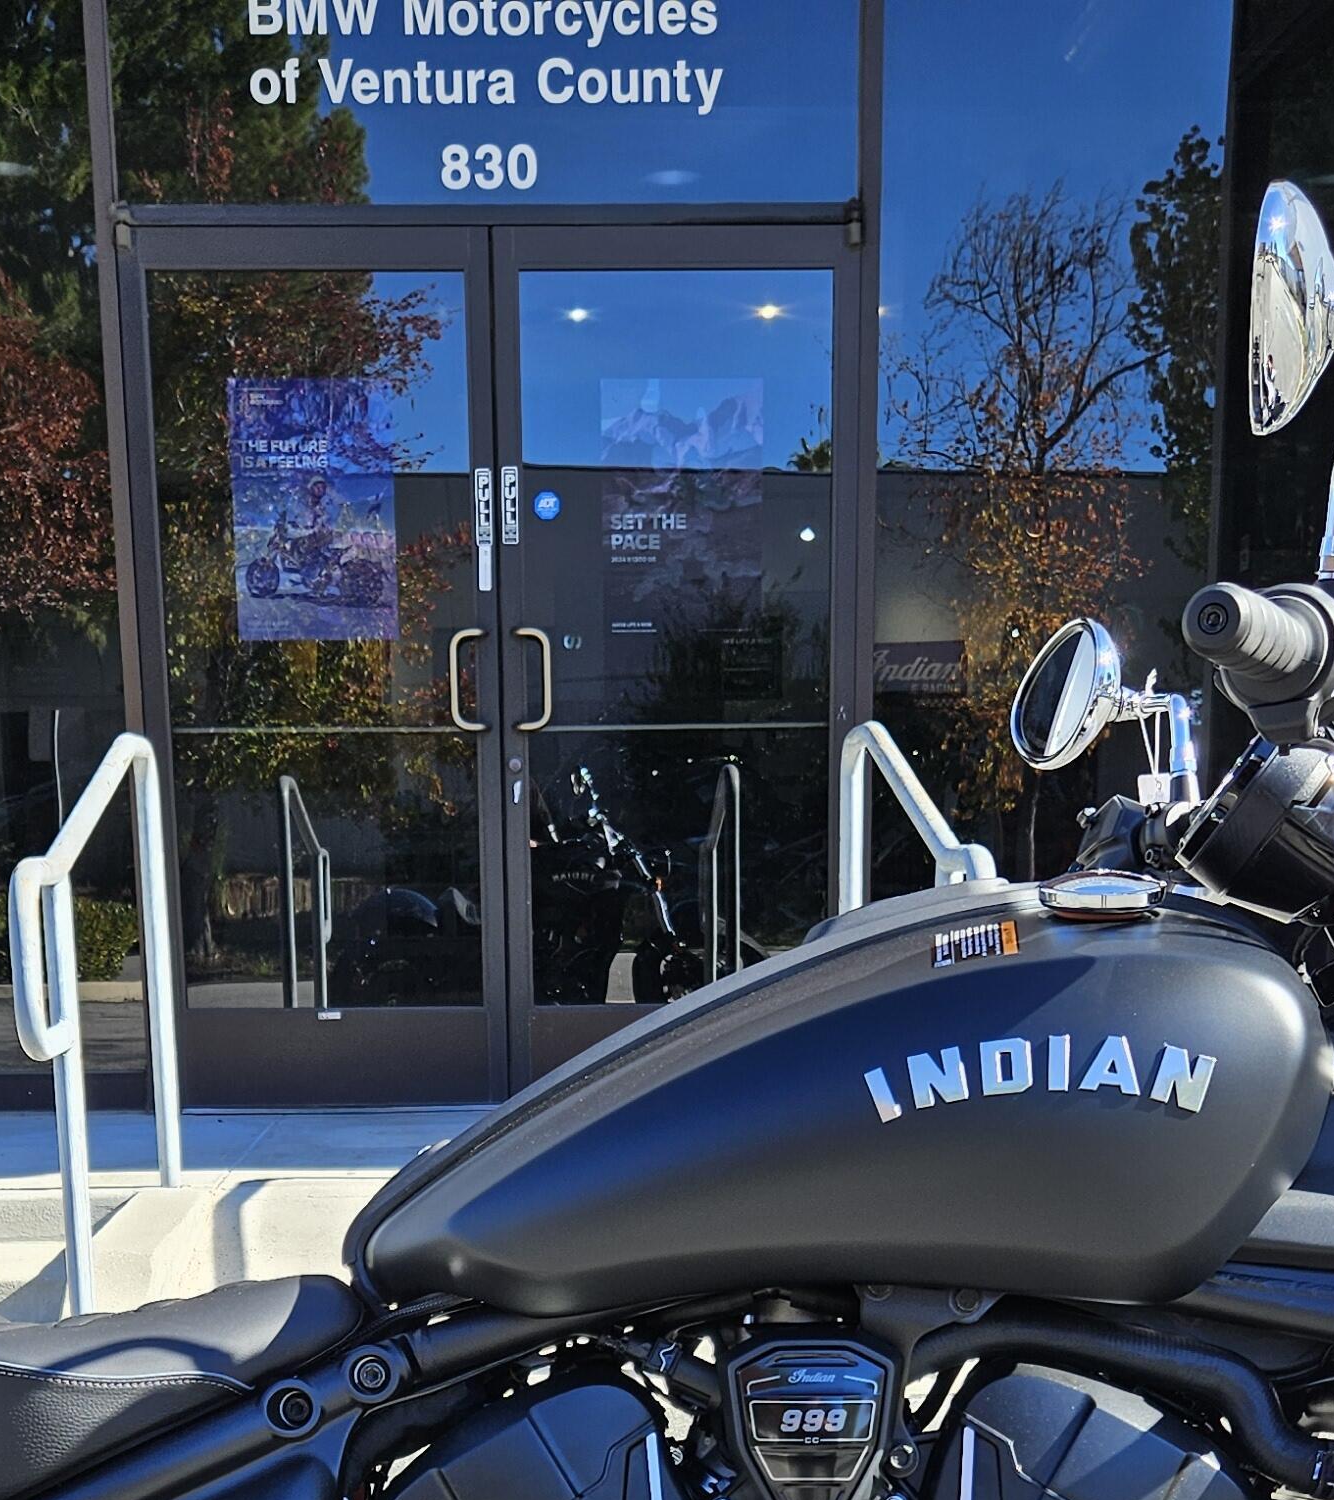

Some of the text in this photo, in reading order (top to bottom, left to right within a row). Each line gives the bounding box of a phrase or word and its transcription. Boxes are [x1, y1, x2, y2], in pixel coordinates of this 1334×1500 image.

[248, 0, 718, 48] BMW Motorcycles
[249, 57, 724, 115] of Ventura County
[440, 143, 538, 190] 830
[238, 439, 328, 453] THE FUTURE
[240, 454, 328, 469] IS A FEELING
[478, 476, 489, 527] PULL
[504, 474, 516, 525] PULL
[538, 498, 557, 508] ADT
[610, 513, 687, 531] SET THE
[610, 533, 661, 551] PACE
[873, 650, 960, 682] Indian
[864, 1034, 1217, 1123] INDIAN
[788, 1369, 836, 1383] Indian
[780, 1408, 847, 1432] 999
